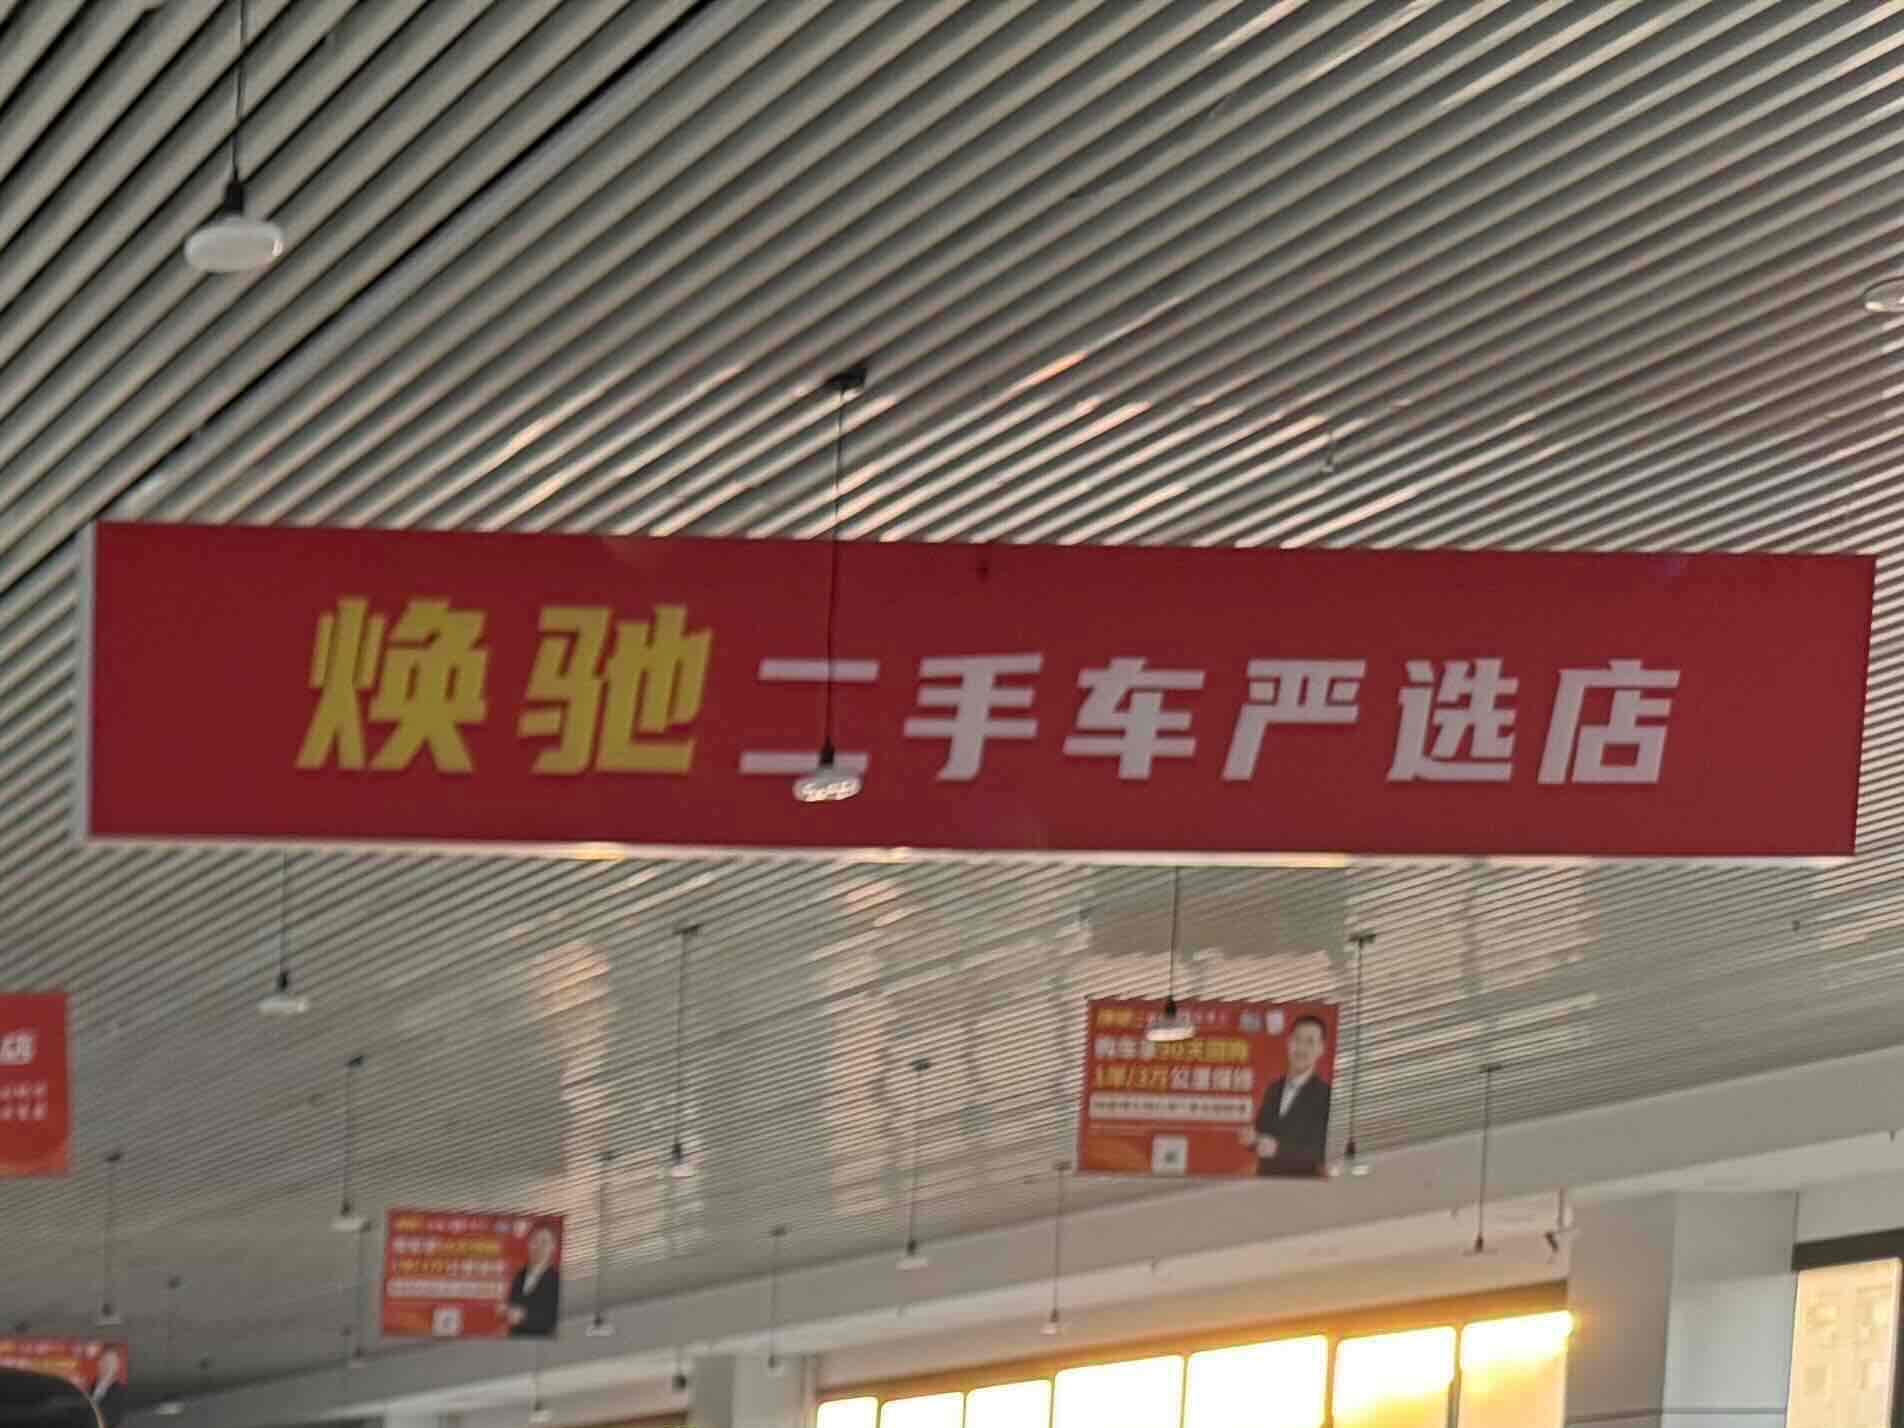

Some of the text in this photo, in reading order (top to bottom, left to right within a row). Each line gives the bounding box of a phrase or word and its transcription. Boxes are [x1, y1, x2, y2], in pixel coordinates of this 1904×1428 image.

[294, 595, 1681, 785] 焕驰二手车严选店
